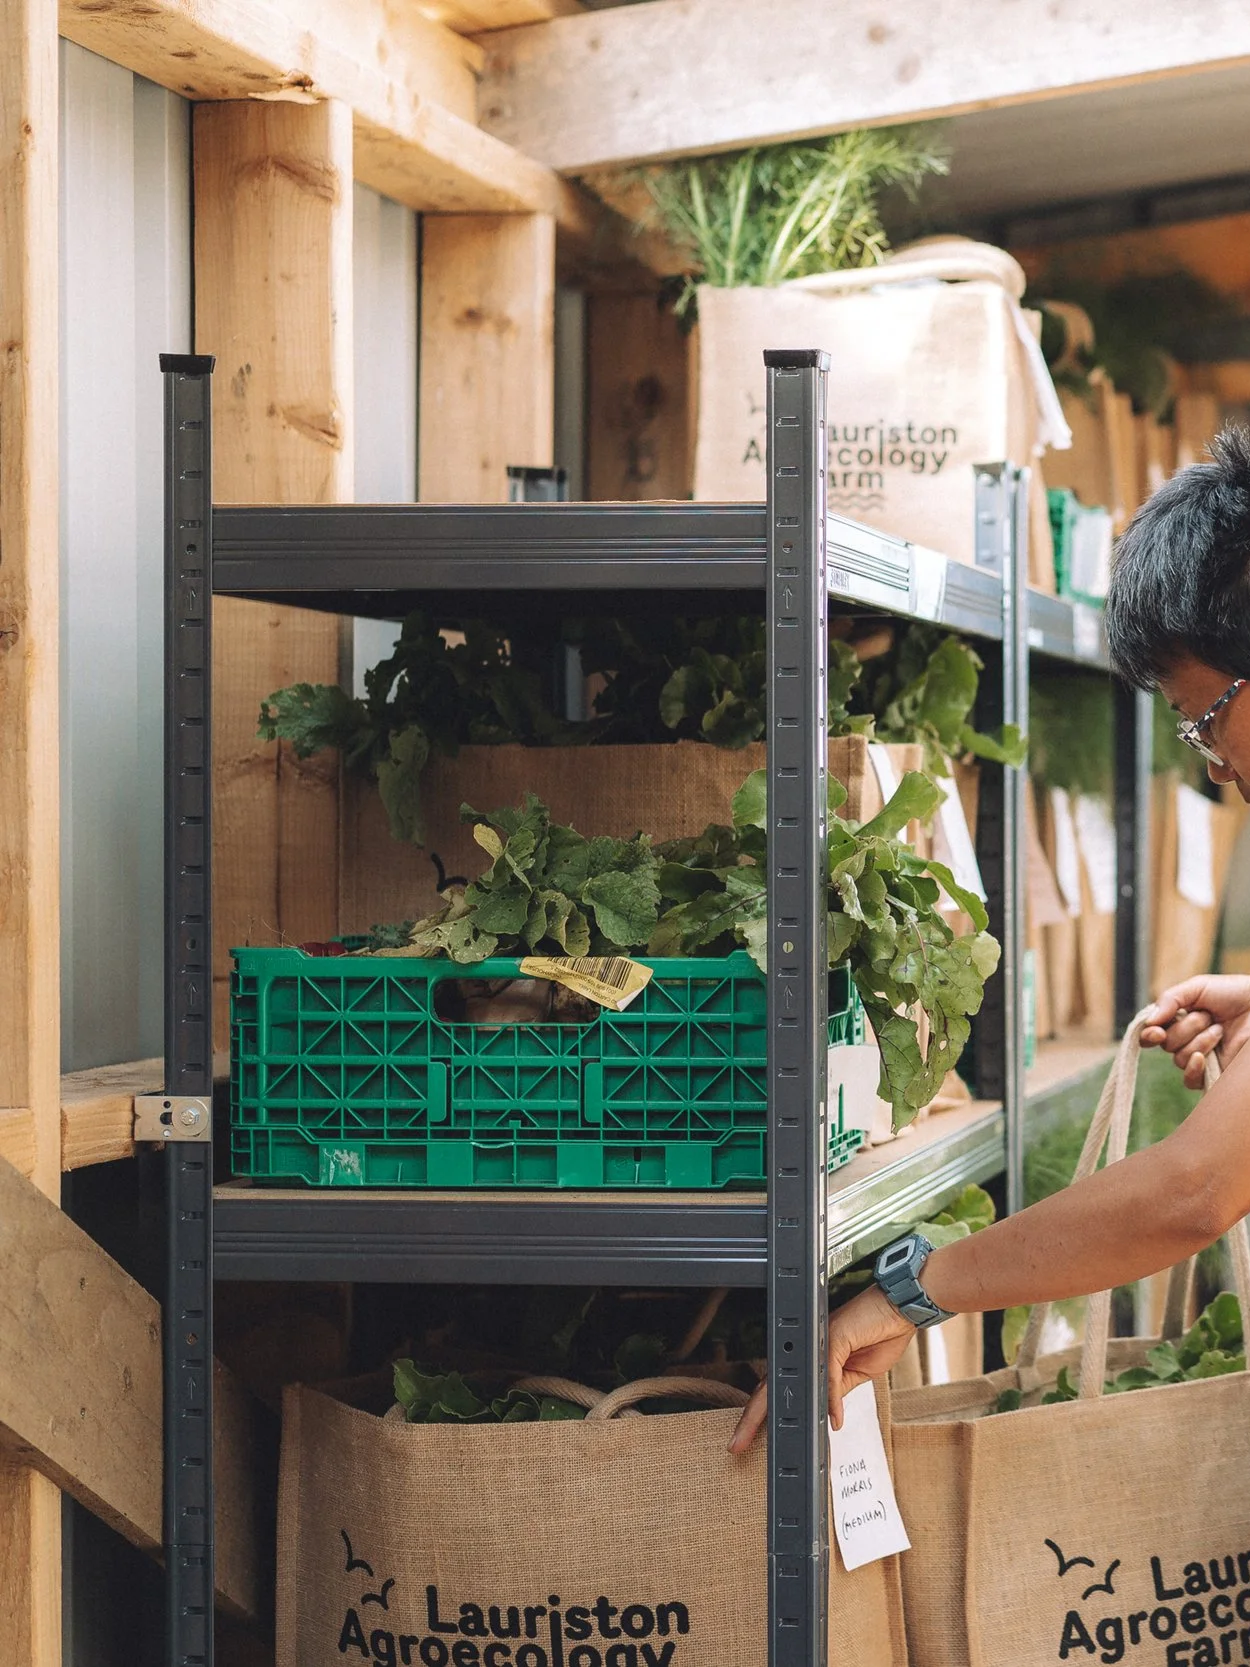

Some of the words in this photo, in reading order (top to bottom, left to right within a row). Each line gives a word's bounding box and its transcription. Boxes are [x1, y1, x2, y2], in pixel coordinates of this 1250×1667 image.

[827, 418, 958, 445] auriston
[827, 470, 884, 488] arm
[839, 1458, 867, 1478] FIONA
[426, 1584, 690, 1640] Lauriston
